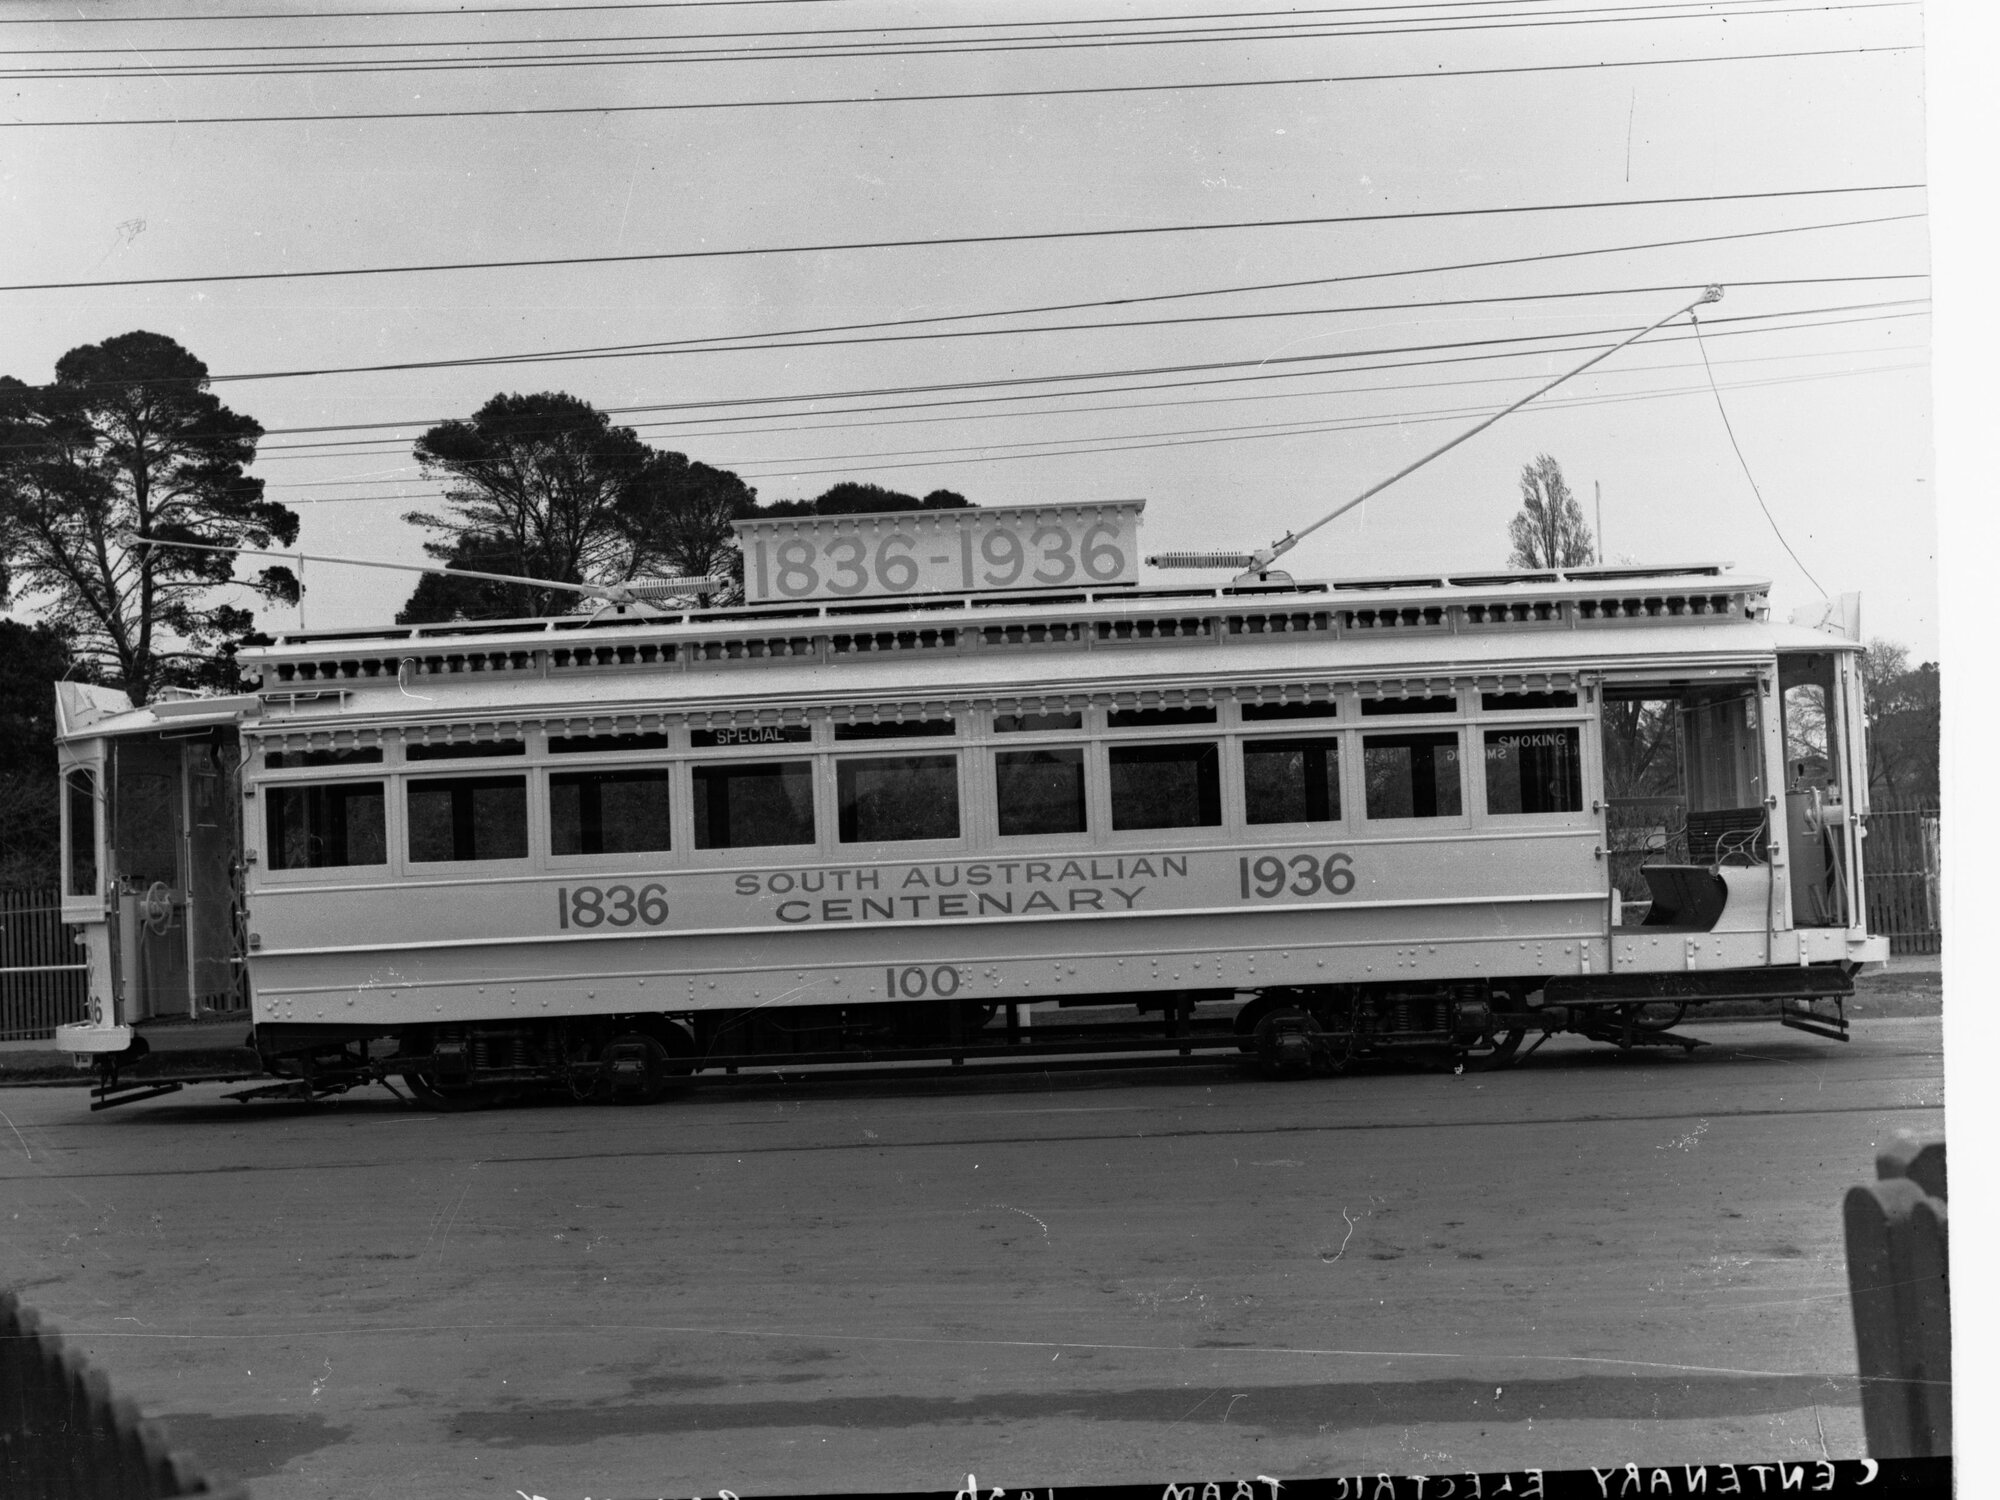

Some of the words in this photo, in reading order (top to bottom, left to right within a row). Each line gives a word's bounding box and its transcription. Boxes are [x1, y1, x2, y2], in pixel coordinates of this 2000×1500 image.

[716, 727, 785, 745] SPECIAL
[1498, 733, 1567, 749] SMOKING
[734, 867, 880, 896] SOUTH
[900, 854, 1189, 889] AUSTRALIAN
[1239, 851, 1356, 900] 1936
[557, 882, 670, 930] 1836
[775, 885, 1148, 924] CENTENARY
[885, 964, 960, 999] 100
